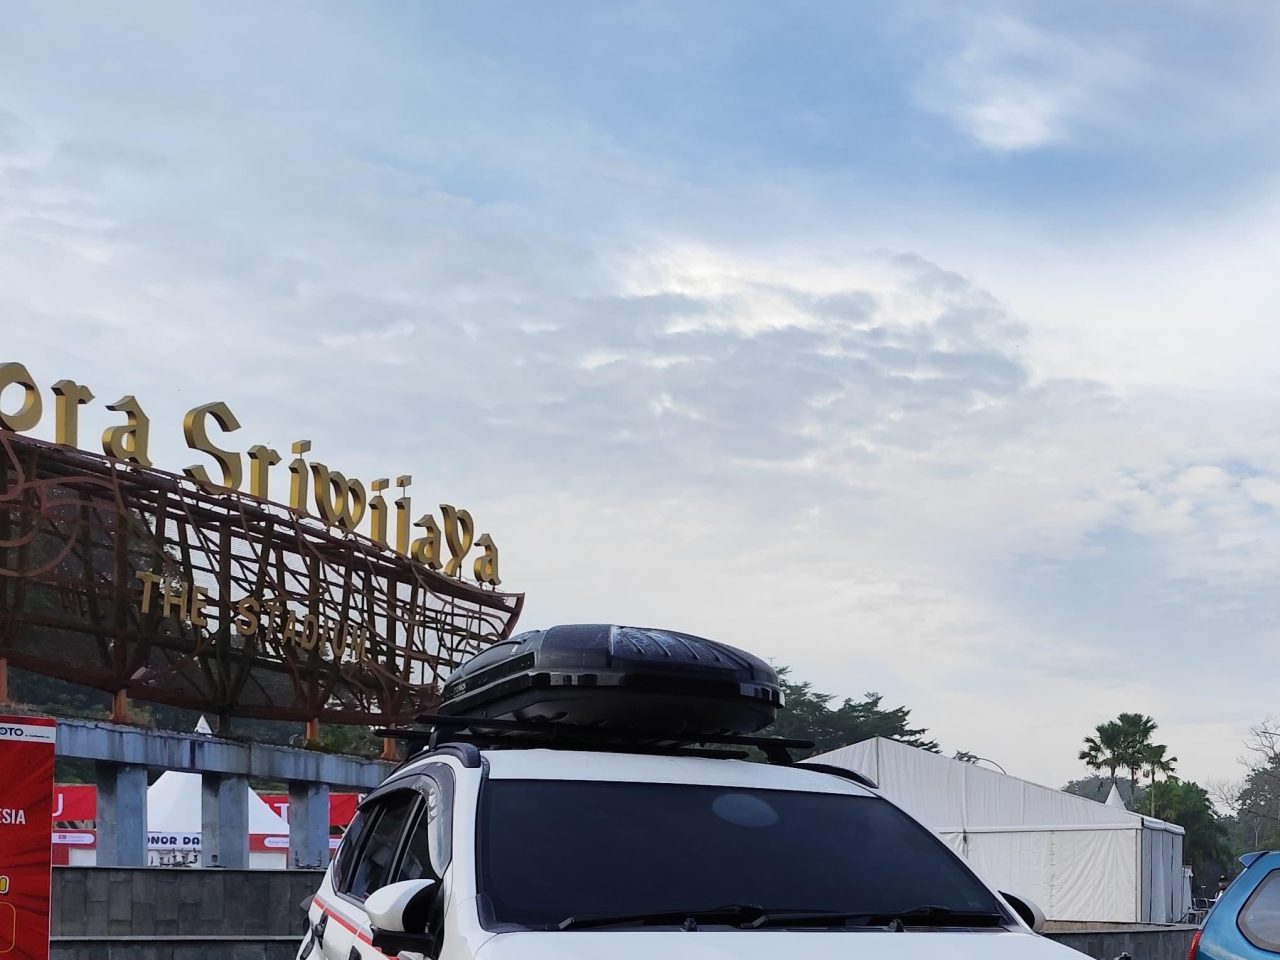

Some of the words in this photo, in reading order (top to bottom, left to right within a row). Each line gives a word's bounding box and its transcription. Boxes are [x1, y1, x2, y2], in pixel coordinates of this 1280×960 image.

[182, 401, 502, 586] Sriwijaya
[136, 571, 208, 628] THE
[235, 596, 368, 661] STADIUM
[148, 836, 177, 845] NOR
